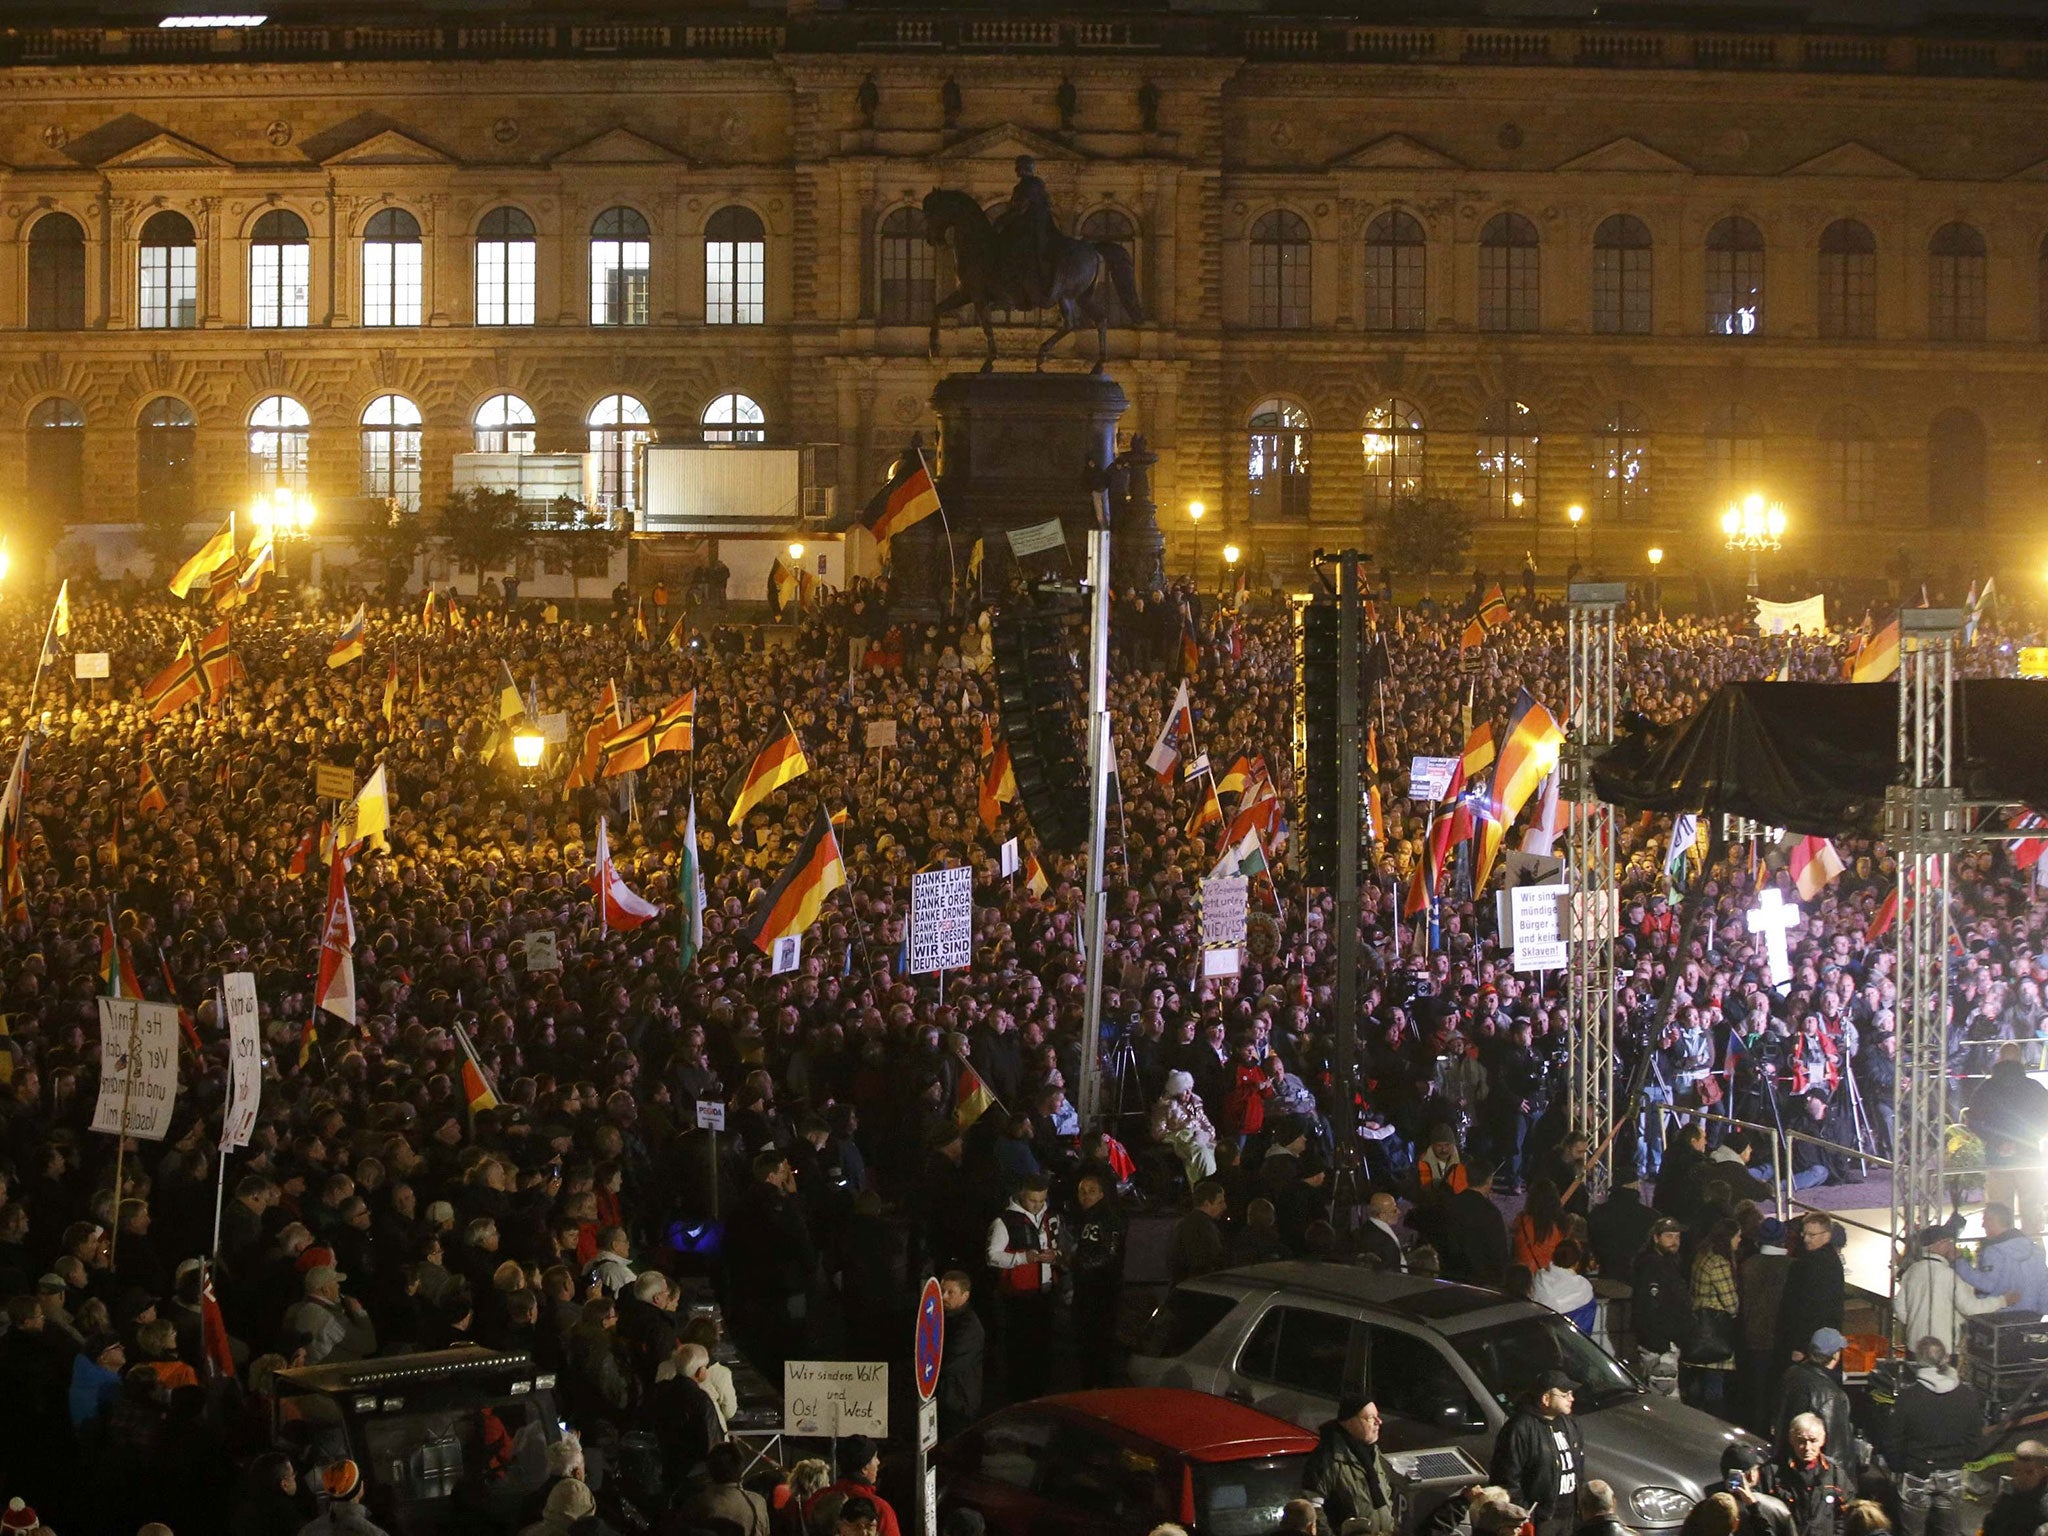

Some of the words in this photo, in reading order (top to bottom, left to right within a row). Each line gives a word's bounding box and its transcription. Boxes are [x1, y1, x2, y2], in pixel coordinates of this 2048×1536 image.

[915, 872, 946, 886] DANKE
[949, 868, 970, 882] LUTZ
[915, 886, 939, 898] DANKE
[941, 882, 970, 896] TATJANA
[1520, 892, 1536, 902] Wir
[1538, 892, 1556, 901] sind
[915, 896, 945, 910] DANKE
[948, 894, 970, 907] ORGA
[914, 910, 940, 922] DANKE
[942, 906, 970, 920] ORDNER
[1520, 906, 1558, 916] mündige
[915, 922, 937, 933] DANKE
[1520, 920, 1548, 930] Bürger
[914, 932, 938, 946] DANKE
[940, 928, 970, 942] DRESDEN
[1518, 934, 1535, 943] und
[1538, 932, 1562, 942] keine
[914, 944, 938, 958] WIR
[942, 940, 970, 954] SIND
[1522, 946, 1559, 956] Sklaven!
[914, 952, 970, 970] DEUTSCHLAND
[788, 1362, 814, 1380] Wir
[827, 1388, 846, 1400] und
[792, 1398, 818, 1417] Ost
[843, 1400, 874, 1418] West
